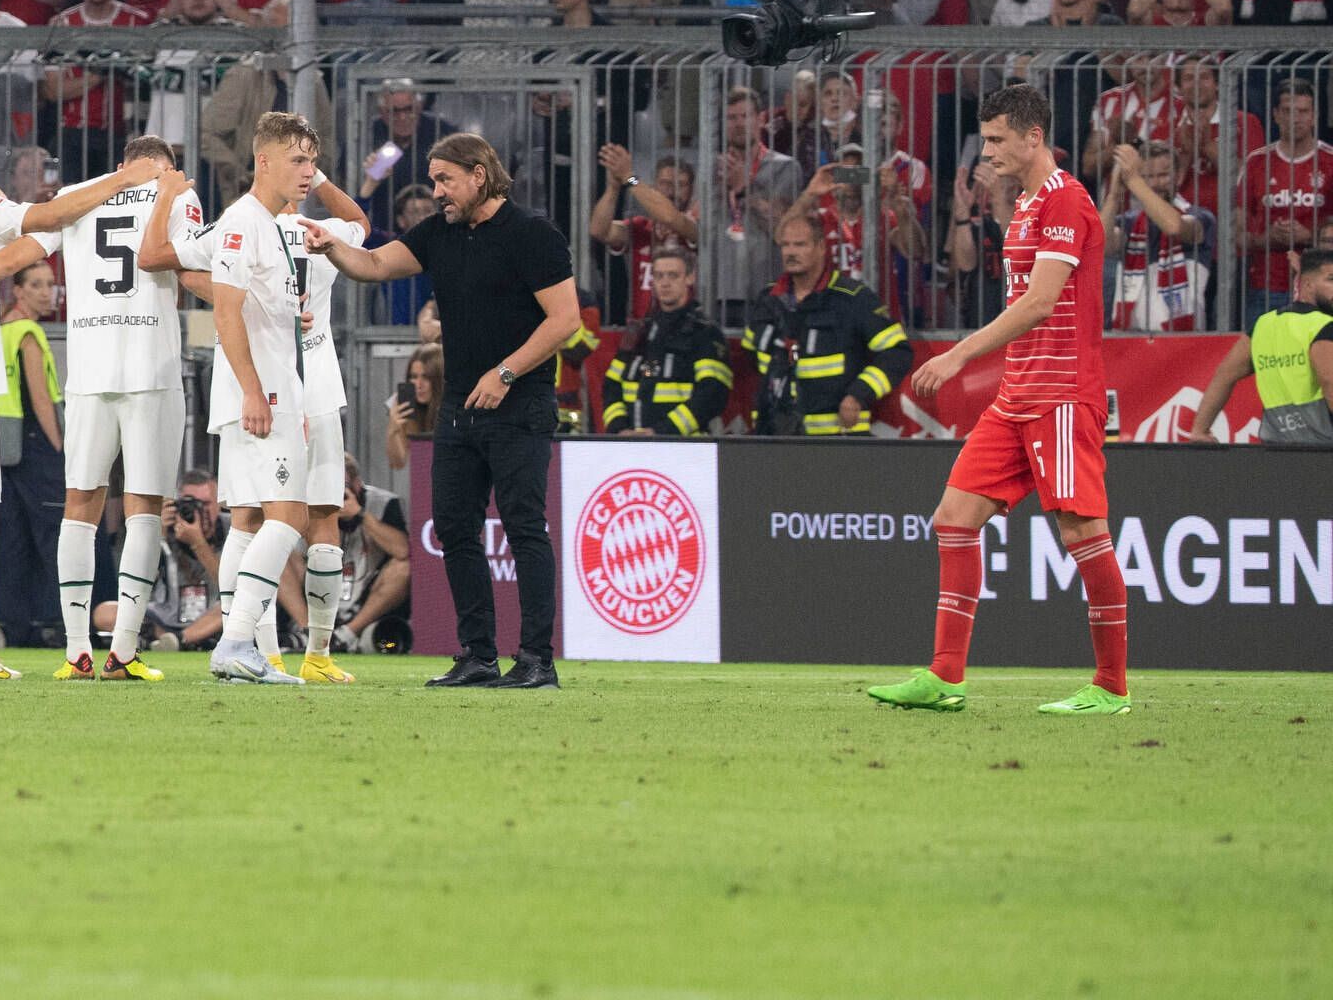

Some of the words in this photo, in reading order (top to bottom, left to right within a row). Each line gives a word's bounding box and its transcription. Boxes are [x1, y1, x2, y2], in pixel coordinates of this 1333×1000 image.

[100, 189, 157, 207] IEDRICH
[1261, 188, 1325, 208] adidas
[1042, 225, 1076, 238] QATAR
[95, 215, 138, 298] 5
[1257, 348, 1306, 371] Steward
[585, 506, 611, 540] FC
[611, 480, 695, 540] BAYERN
[770, 512, 896, 540] POWERED
[902, 514, 934, 542] BY
[587, 566, 695, 625] MÜNCHEN
